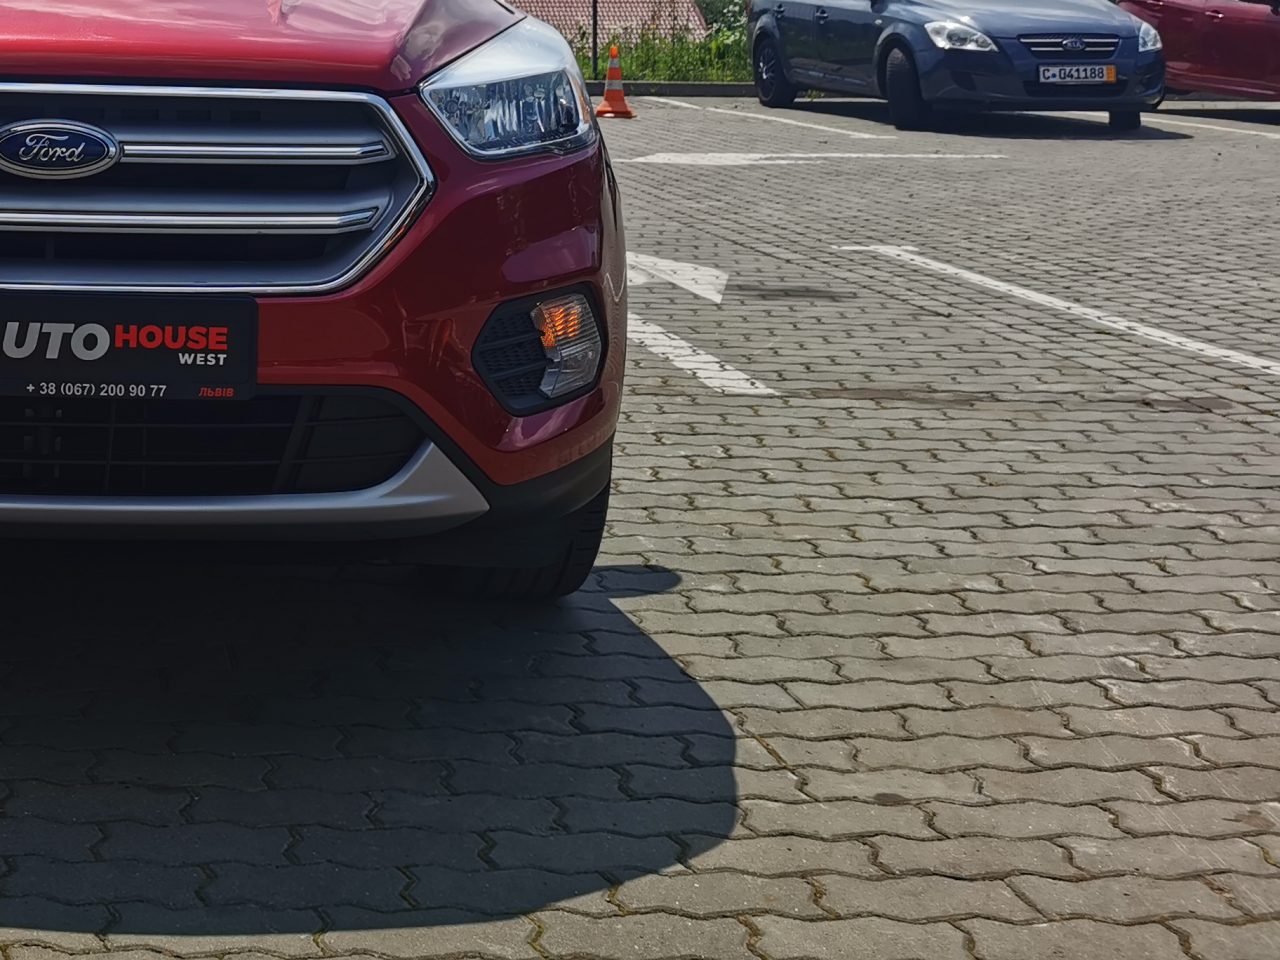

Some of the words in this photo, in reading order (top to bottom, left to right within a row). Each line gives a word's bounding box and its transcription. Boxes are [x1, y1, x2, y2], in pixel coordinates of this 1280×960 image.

[19, 133, 85, 162] Ford
[114, 324, 229, 351] HOUSE
[178, 352, 228, 366] WEST
[39, 382, 56, 395] 38
[60, 382, 96, 396] (067)
[99, 384, 125, 397] 200
[129, 384, 146, 397] 90
[149, 385, 167, 397] 77
